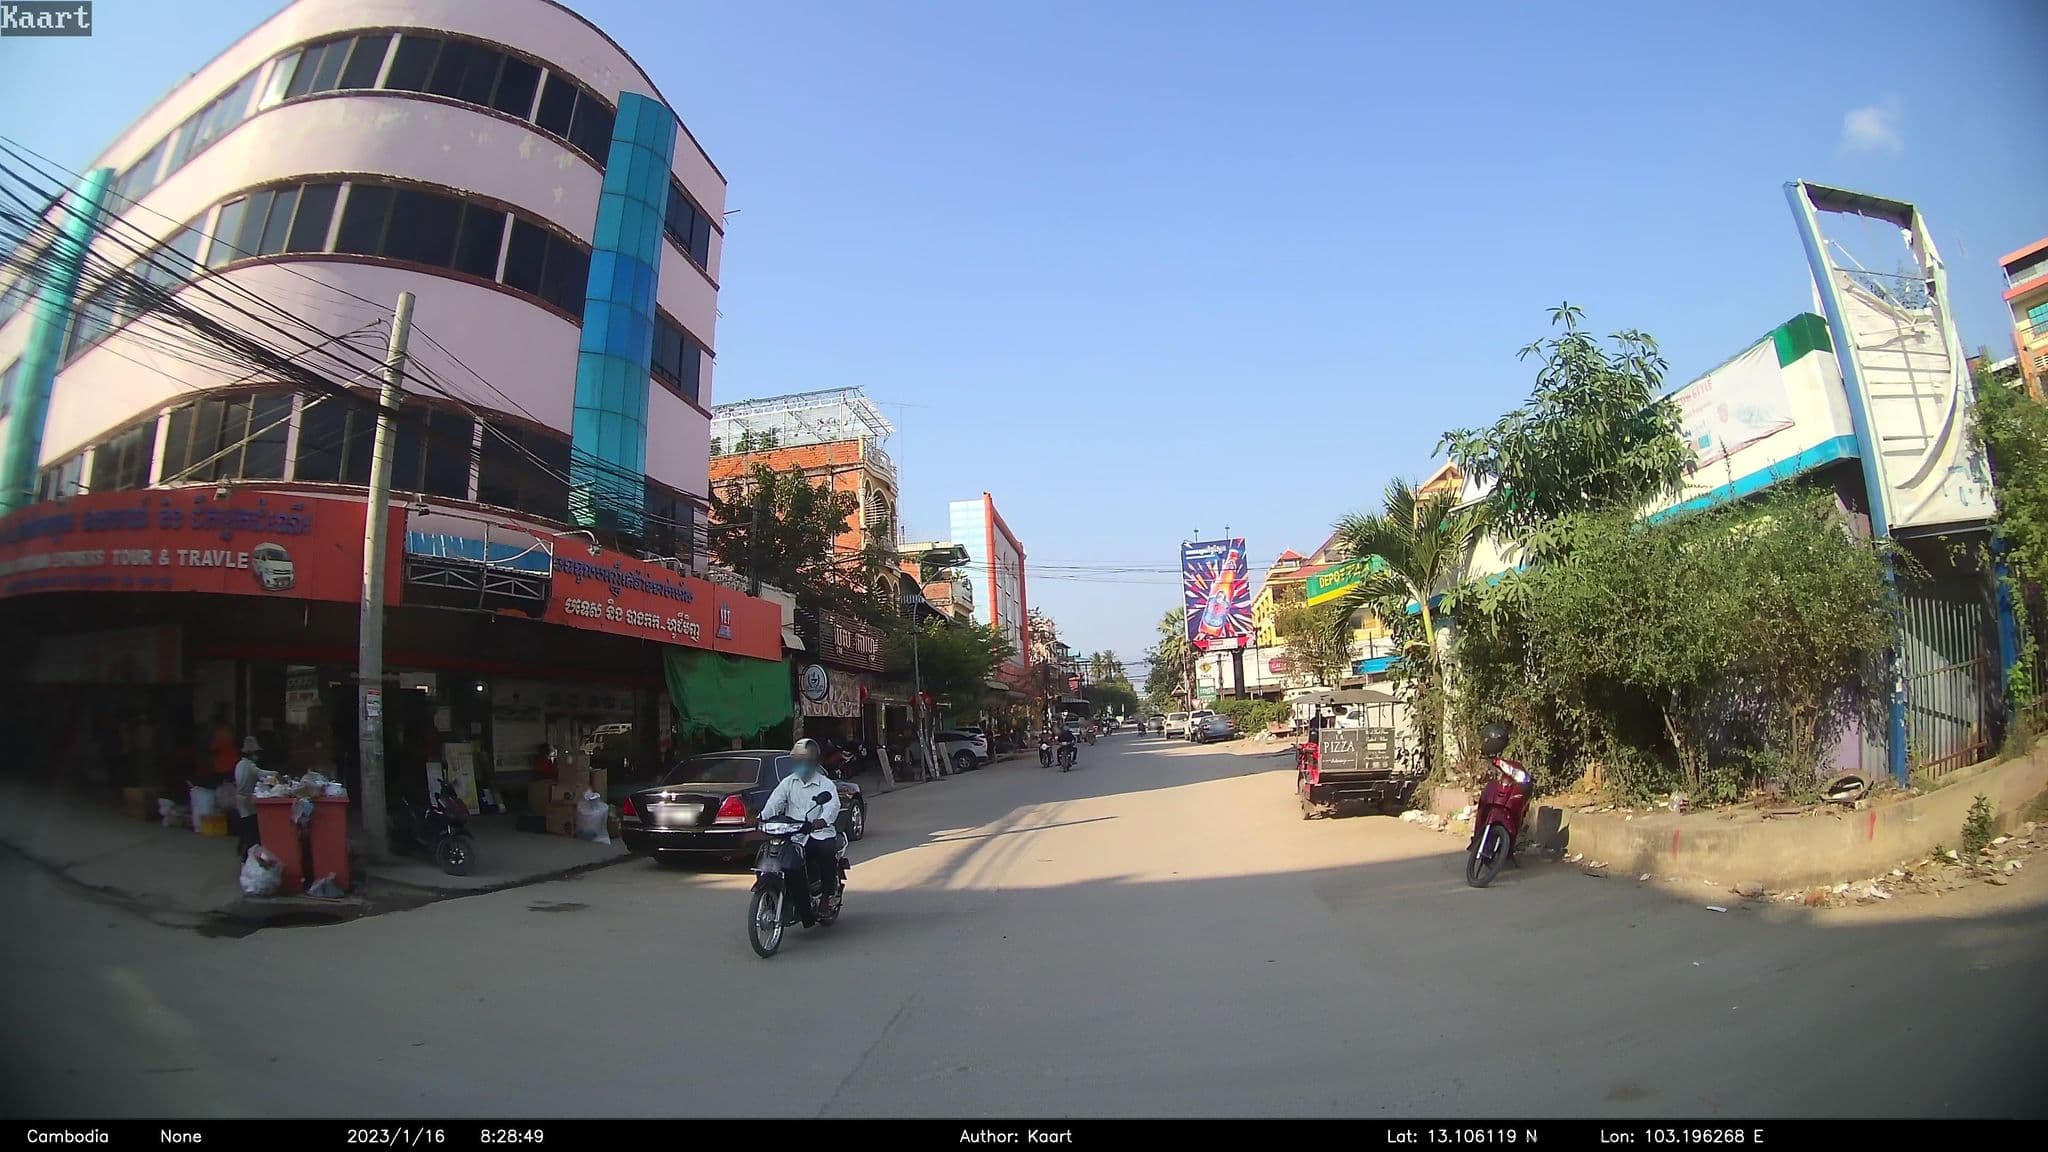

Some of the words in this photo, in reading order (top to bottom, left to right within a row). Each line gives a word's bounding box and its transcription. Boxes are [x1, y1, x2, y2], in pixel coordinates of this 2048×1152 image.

[112, 548, 153, 567] TOUR
[158, 548, 170, 566] &
[177, 549, 249, 569] TRAVLE
[1324, 740, 1355, 754] PIZZA
